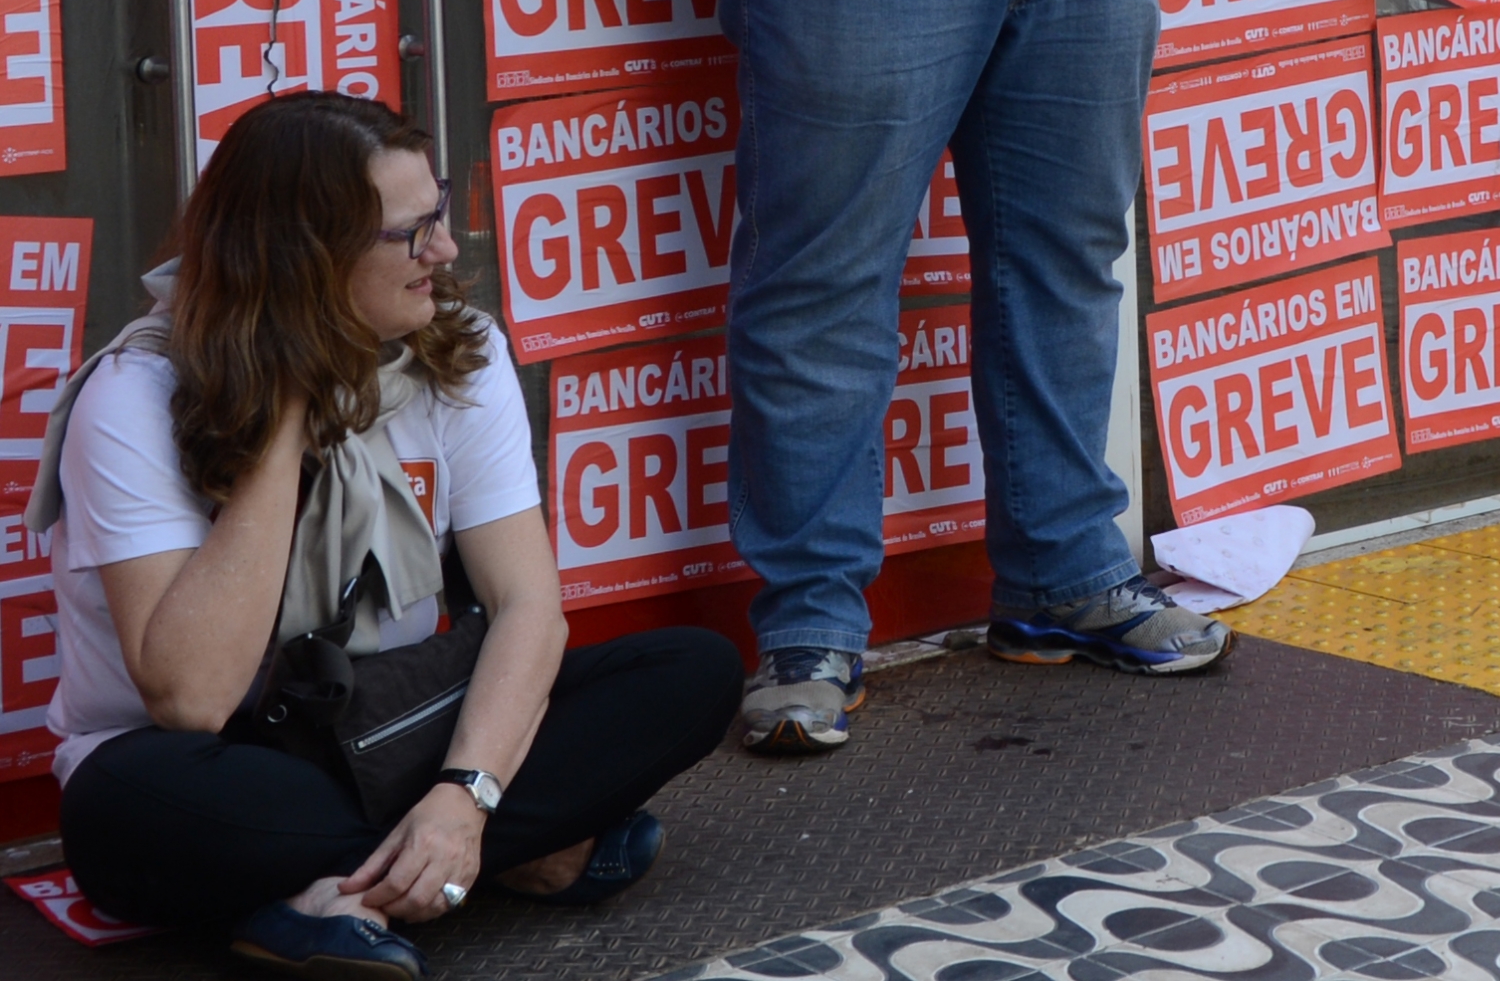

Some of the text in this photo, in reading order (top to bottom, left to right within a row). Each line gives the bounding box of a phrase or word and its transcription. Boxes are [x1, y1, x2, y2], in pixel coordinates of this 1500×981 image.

[1245, 27, 1264, 41] CUT
[624, 59, 650, 72] CUT
[498, 96, 728, 171] BANCÁRIOS
[1151, 87, 1369, 221] GREVE
[1468, 191, 1486, 203] CUT
[1158, 196, 1382, 285] BANCÁRIOS EM
[10, 241, 80, 291] EM
[639, 312, 665, 326] CUT
[1154, 274, 1376, 369] BANCÁRIOS EM
[556, 351, 727, 418] BANCÁRI
[1167, 334, 1385, 480] GREVE
[1263, 480, 1282, 494] CUT
[683, 562, 707, 576] CUT
